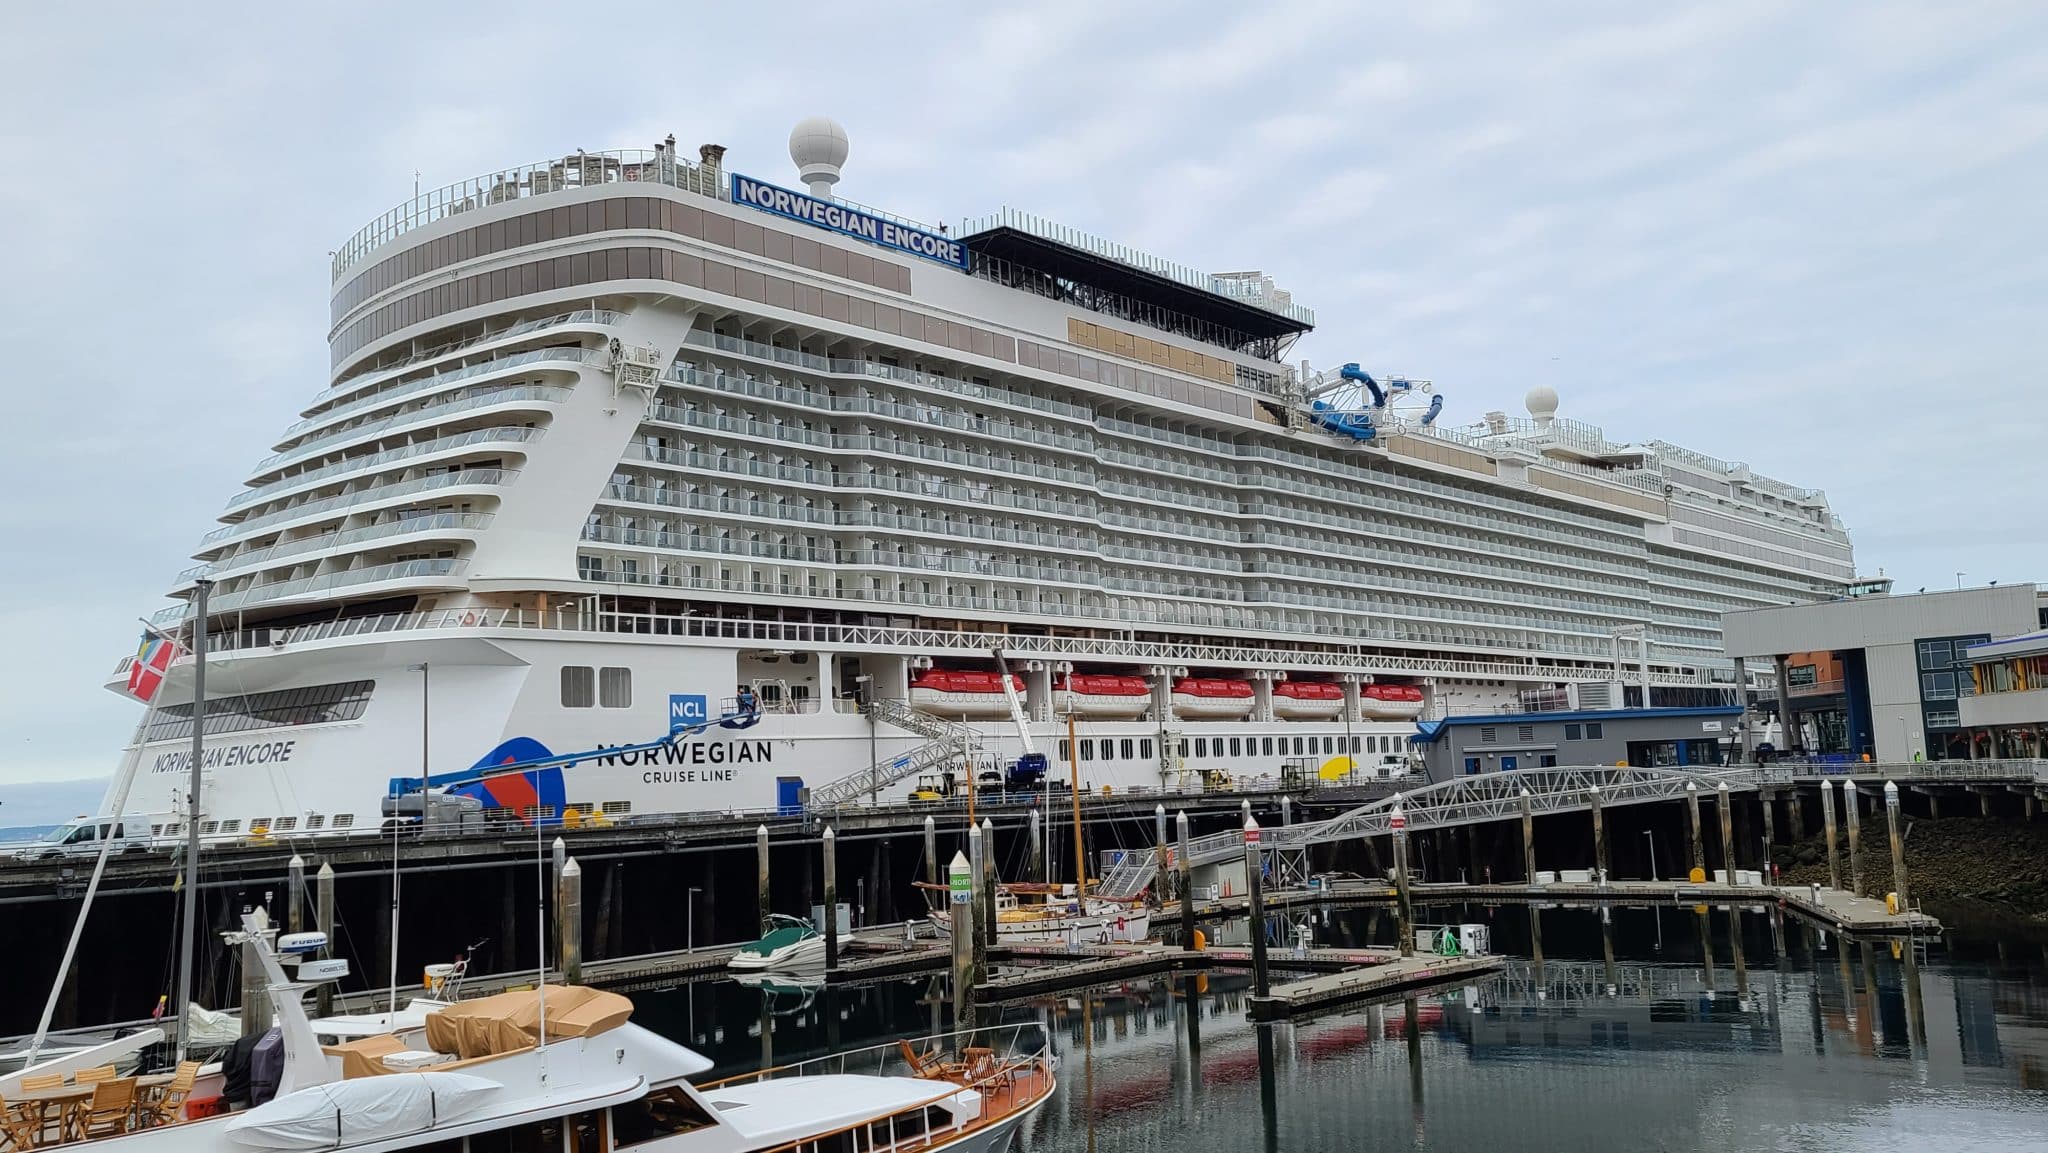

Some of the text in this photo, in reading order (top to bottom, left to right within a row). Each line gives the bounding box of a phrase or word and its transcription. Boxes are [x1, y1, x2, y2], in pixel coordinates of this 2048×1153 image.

[740, 179, 961, 263] NORWEGIAN ENCORE
[671, 702, 704, 717] NCL
[152, 741, 295, 773] NORWEIAN ENCORE
[597, 741, 772, 767] NORWEGIAN
[936, 760, 992, 772] NORWIAN
[643, 771, 695, 784] CRUISE
